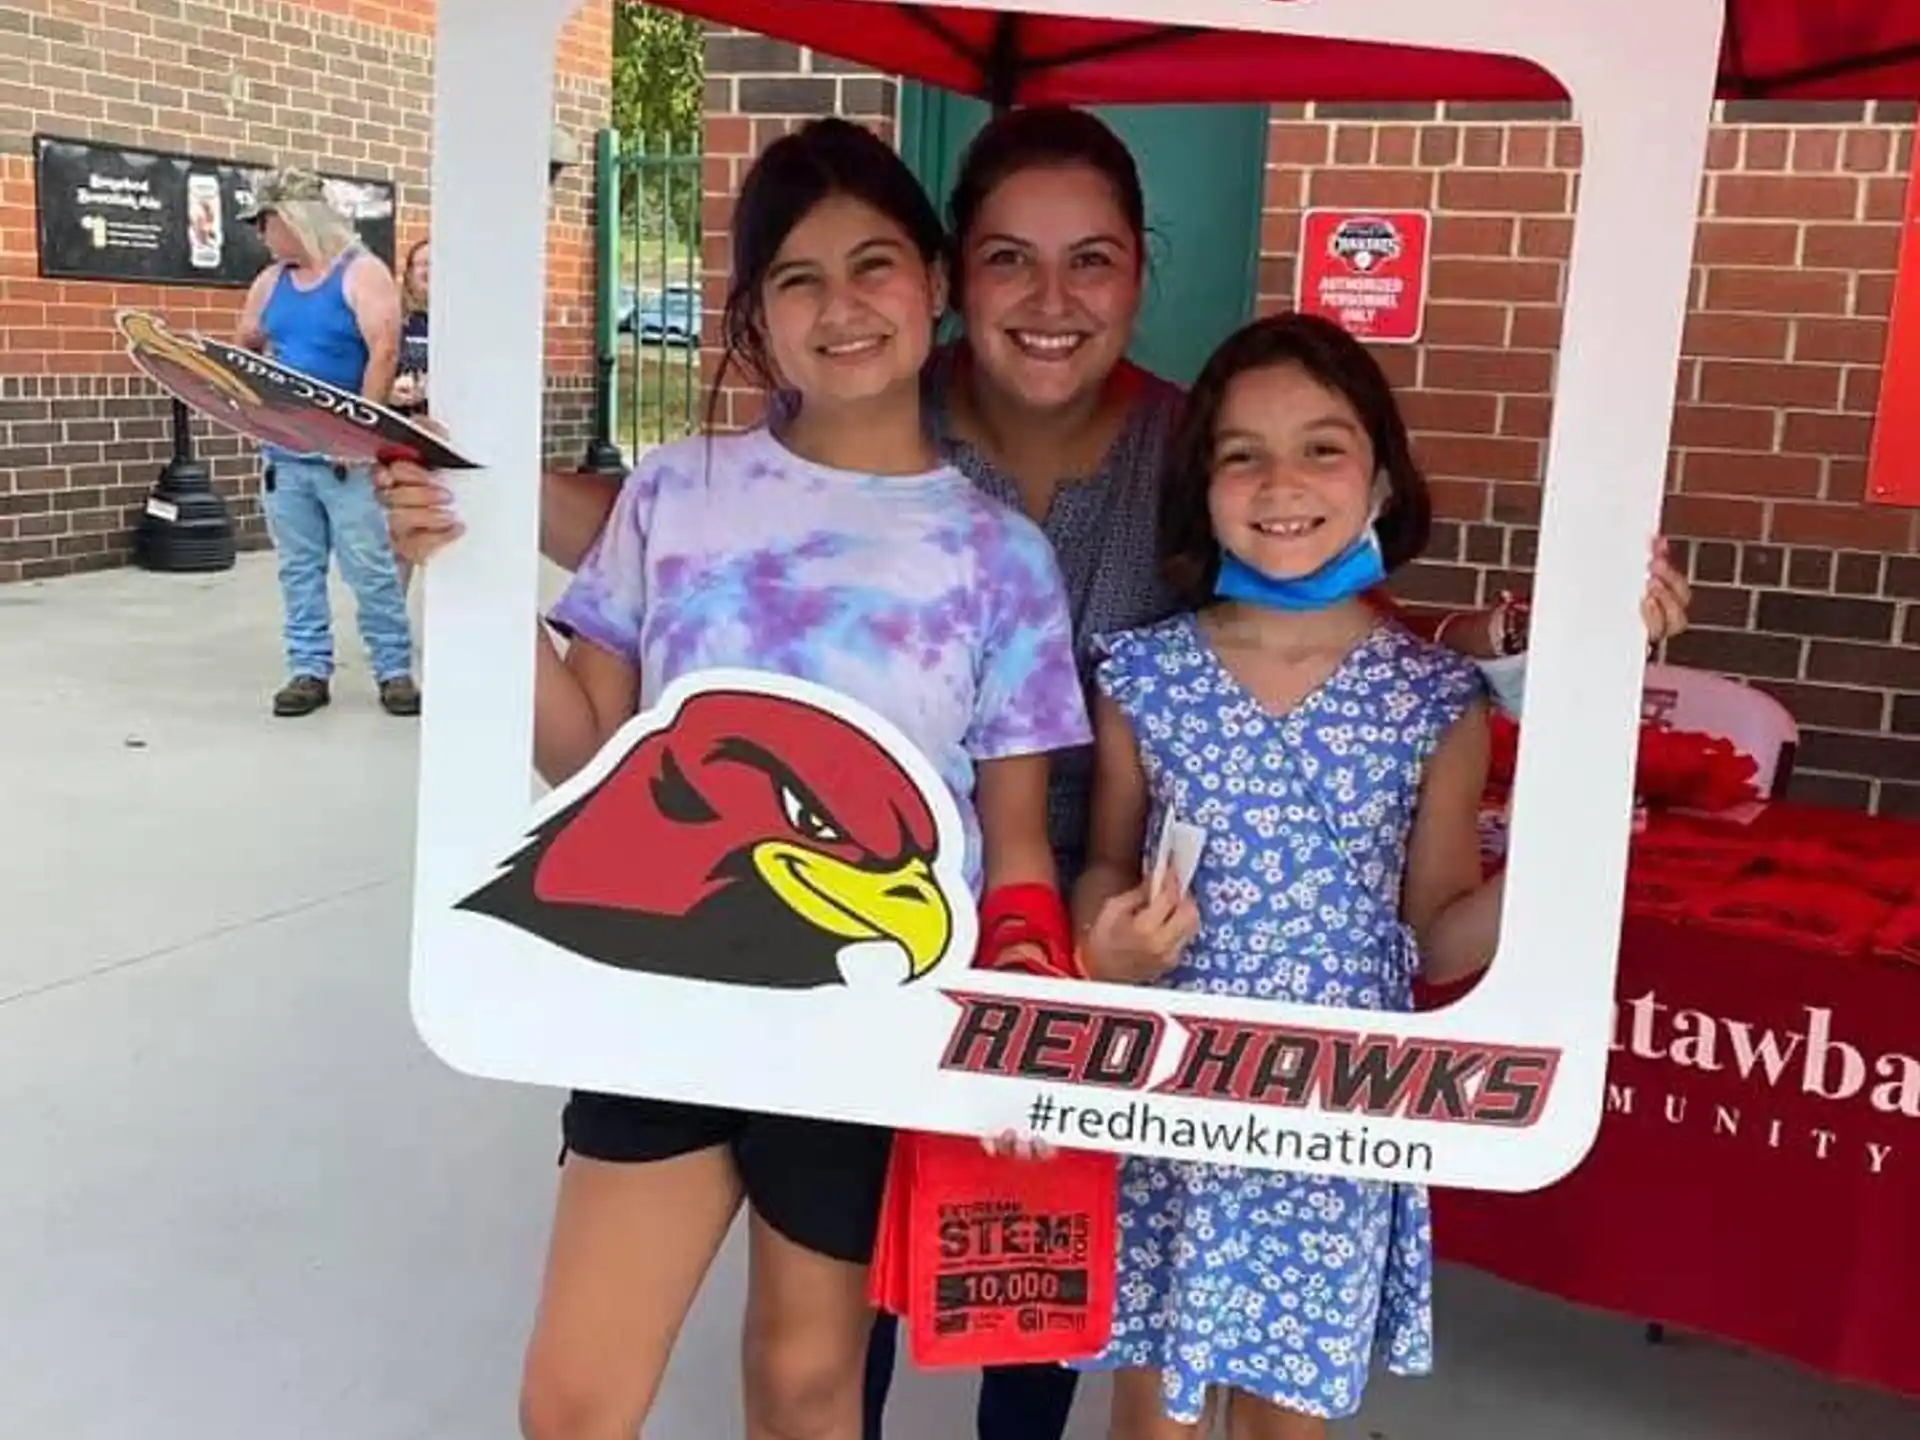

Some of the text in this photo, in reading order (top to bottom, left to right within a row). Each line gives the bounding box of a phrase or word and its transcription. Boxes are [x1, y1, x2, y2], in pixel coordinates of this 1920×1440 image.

[1318, 276, 1403, 294] AUTHORIZED
[1321, 292, 1399, 309] PERSONNEL
[1340, 308, 1376, 323] ONLY
[939, 989, 1563, 1127] RED HAWKS
[1607, 990, 1920, 1118] tawba
[1027, 1094, 1434, 1171] #redhawknation
[940, 1212, 1073, 1258] STEM
[964, 1272, 1060, 1304] 10,000
